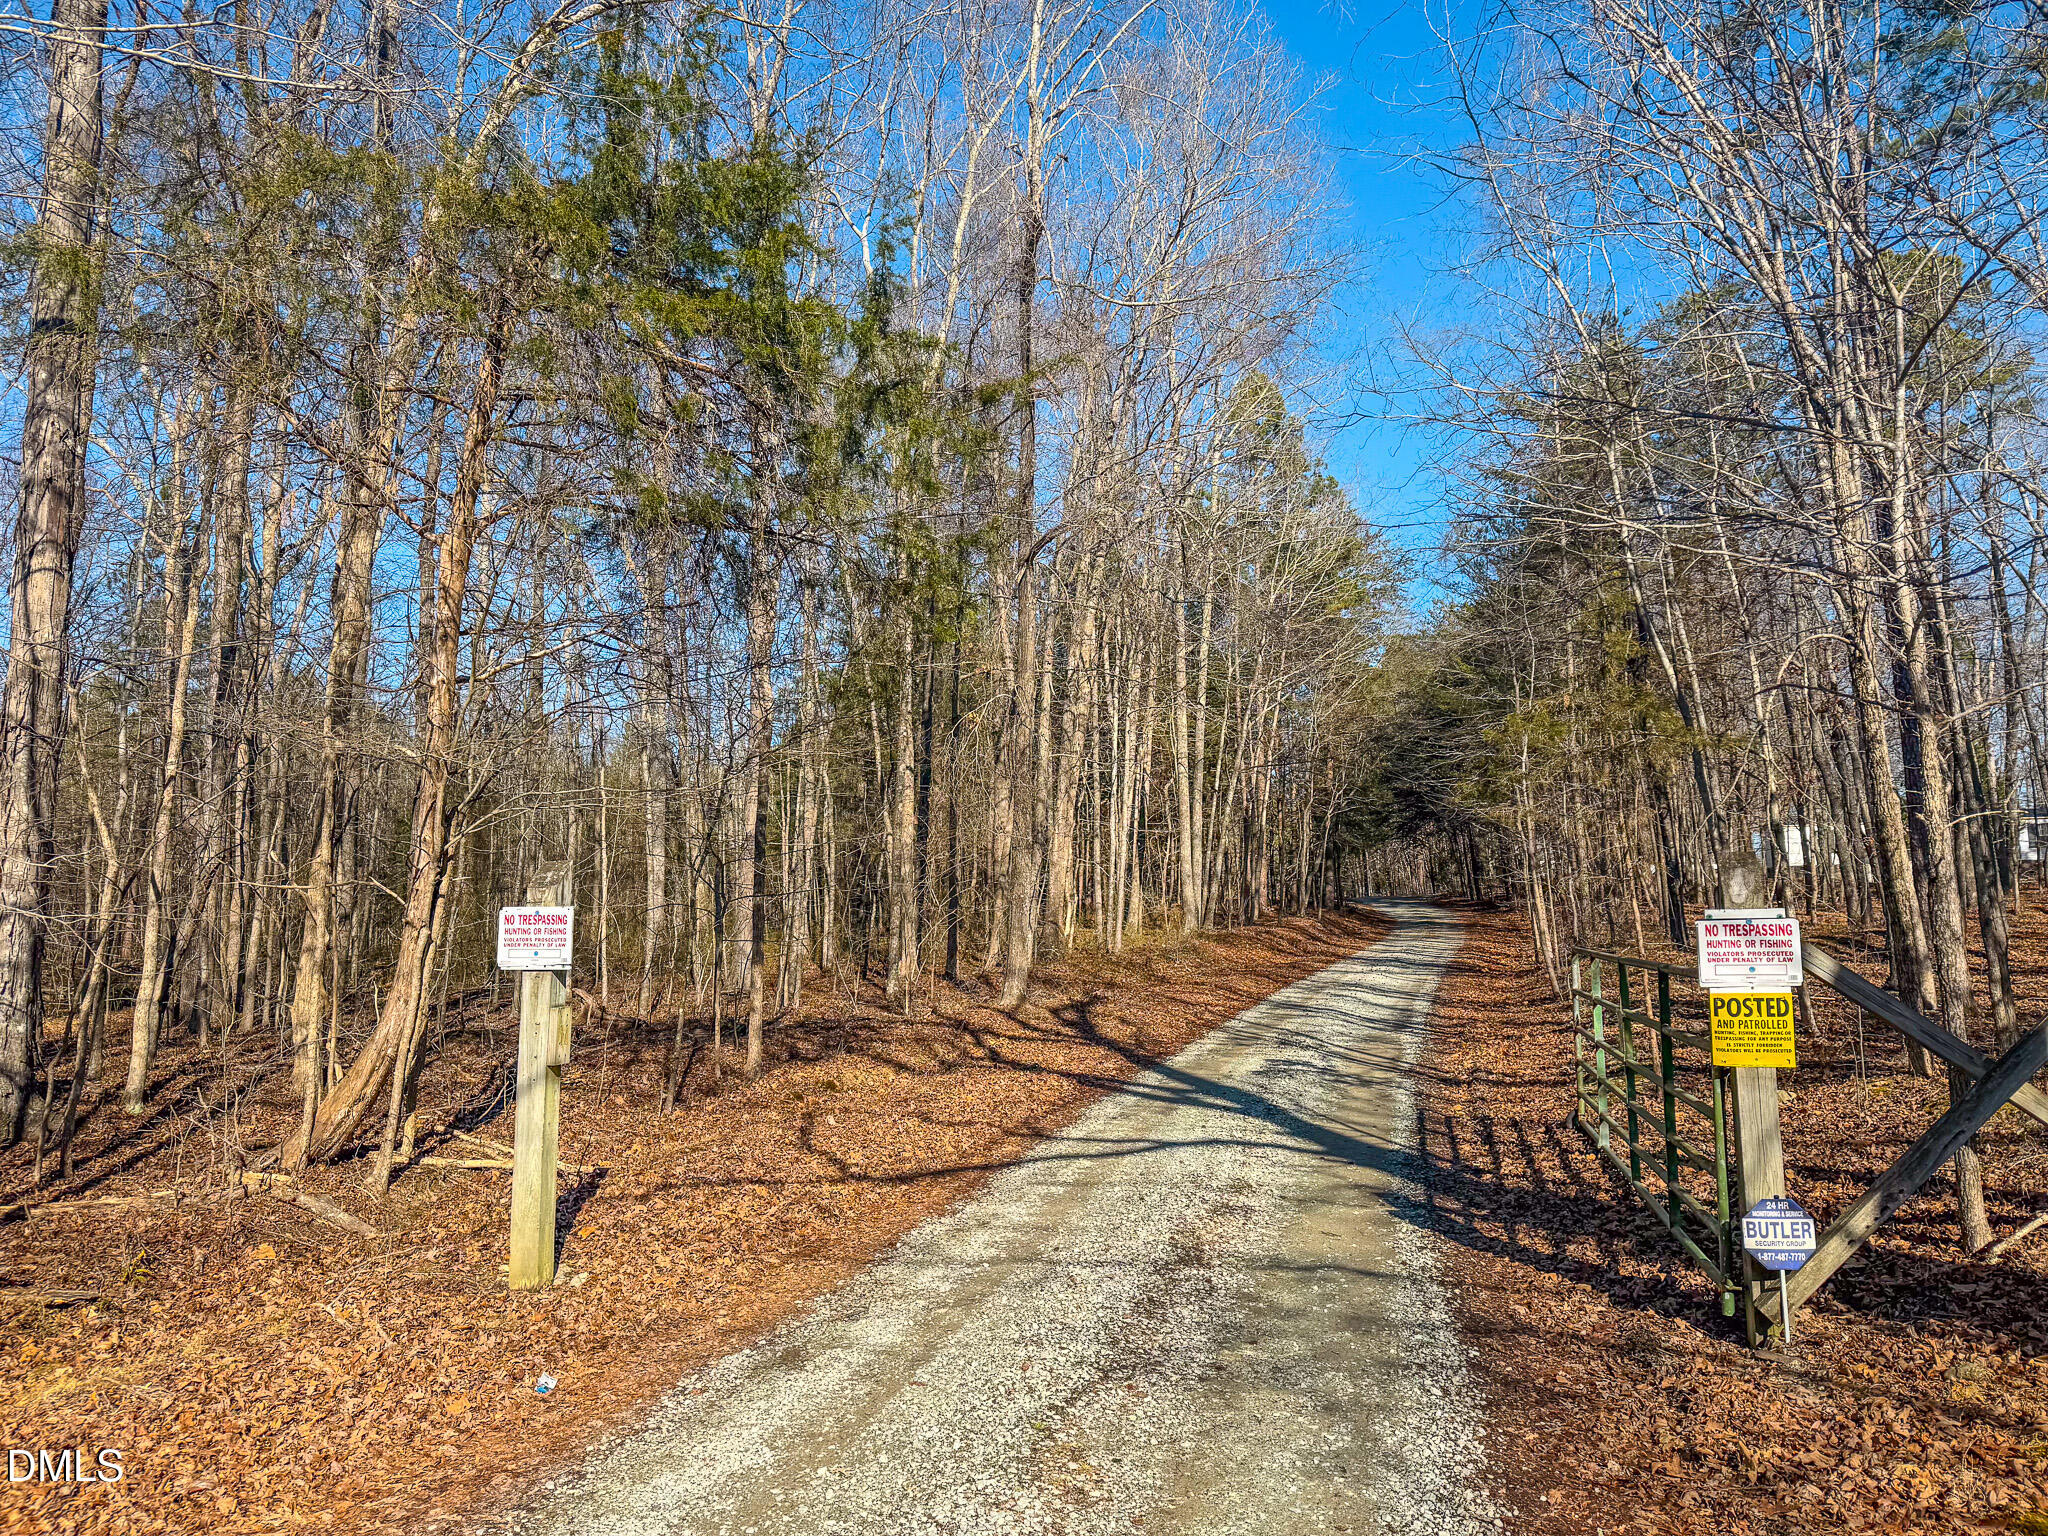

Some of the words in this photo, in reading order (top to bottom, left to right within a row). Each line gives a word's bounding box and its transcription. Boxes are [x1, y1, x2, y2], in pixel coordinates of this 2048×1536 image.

[504, 915, 515, 925] NO
[518, 915, 567, 925] TRESPASSING
[1705, 924, 1718, 936] NO
[1723, 924, 1793, 936] TRESPASSING
[1707, 940, 1741, 948] HUNTING
[1745, 940, 1756, 948] OR
[1760, 940, 1792, 948] FISHING
[1713, 998, 1789, 1017] POSTED
[1717, 1020, 1735, 1029] AND
[1738, 1020, 1788, 1029] PATROLLED
[1746, 1221, 1812, 1239] BUTLER
